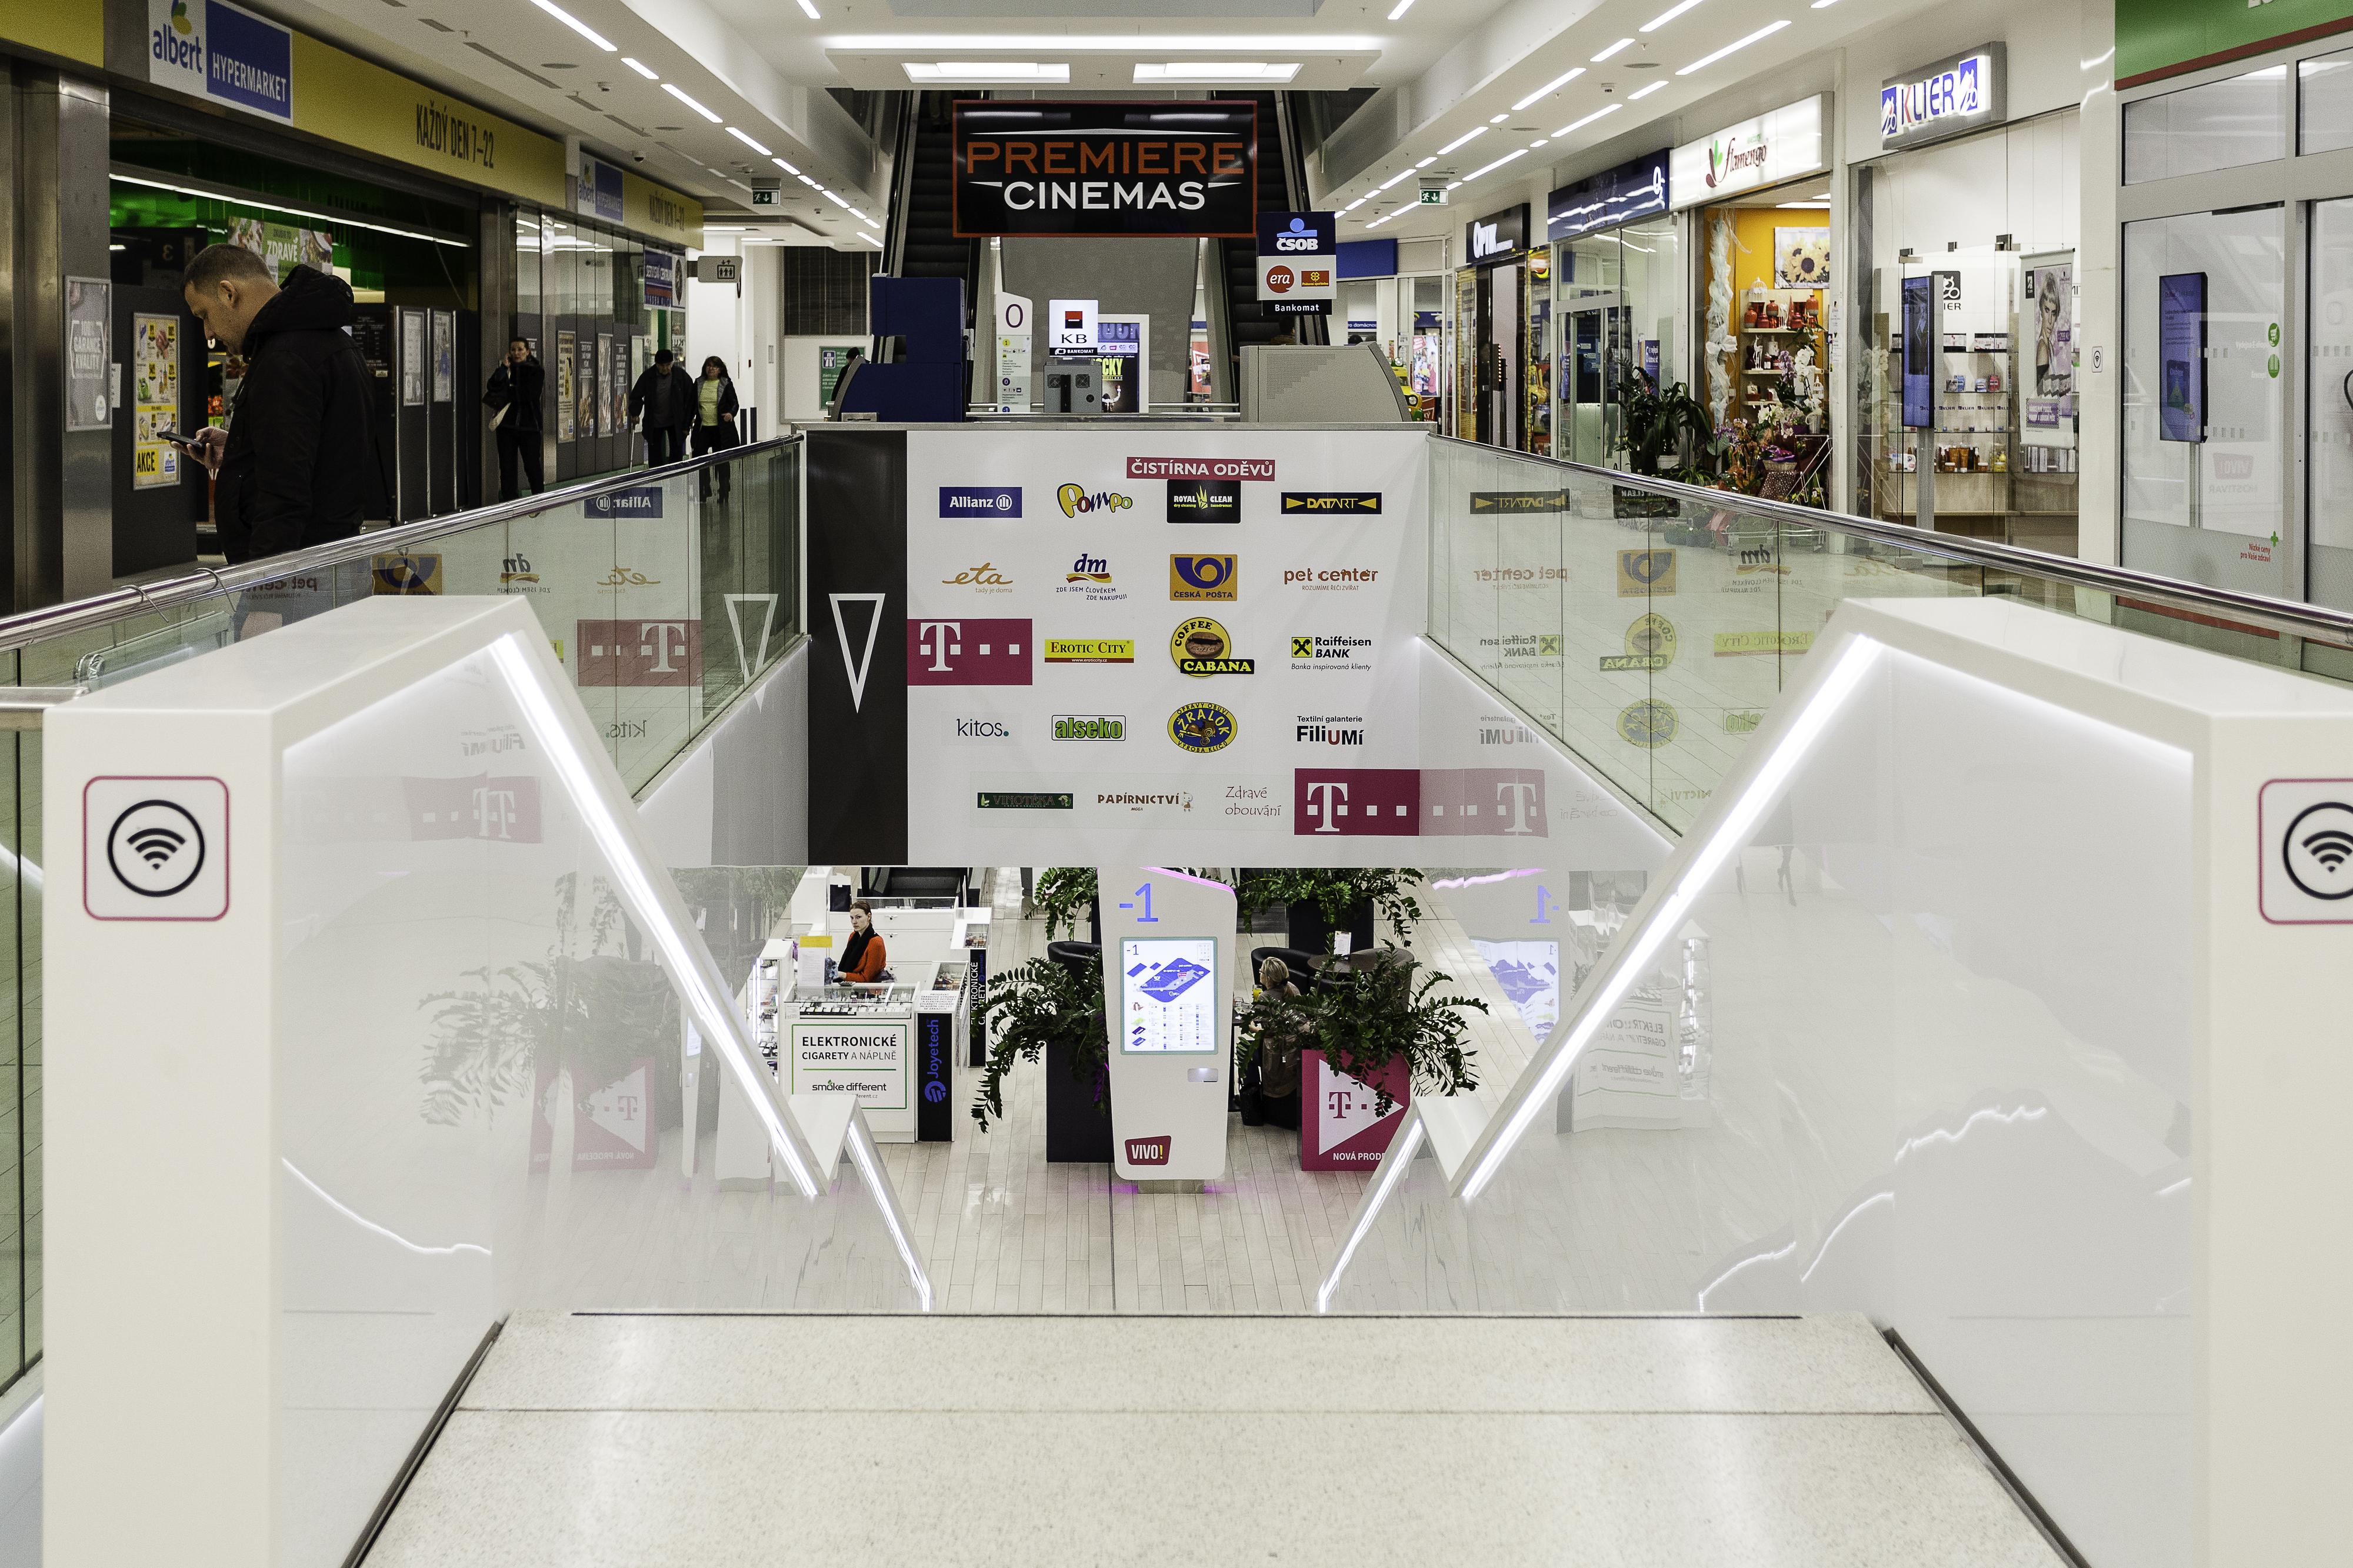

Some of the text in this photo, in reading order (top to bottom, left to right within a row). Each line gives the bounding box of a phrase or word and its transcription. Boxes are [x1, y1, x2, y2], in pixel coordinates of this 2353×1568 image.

[152, 24, 202, 74] albert
[213, 52, 286, 102] HYPERMARKET
[1902, 74, 1954, 125] KLIER
[416, 99, 448, 153] KAŽDÝ
[451, 116, 469, 161] DEN
[966, 142, 1244, 174] PREMIERE
[1004, 181, 1205, 209] CINEMAS
[267, 237, 298, 262] ZDRAVÉ
[1277, 238, 1318, 251] ČSOB
[1270, 274, 1290, 284] era
[1005, 303, 1023, 328] 0
[1061, 334, 1087, 343] KB
[137, 451, 155, 473] AKCE
[1131, 458, 1273, 477] ČISTÍRNA ODĚVŮ
[949, 496, 994, 508] Allianz
[1056, 483, 1134, 519] Pompo
[1307, 498, 1358, 509] DATART
[1074, 553, 1107, 572] dm
[942, 562, 1013, 585] eta
[1284, 568, 1378, 585] pet center
[1173, 589, 1233, 598] ČESKÁ POŠTA
[1174, 620, 1213, 647] COFFEE
[1315, 636, 1372, 646] Raiffeisen
[1315, 649, 1351, 658] BANK
[1184, 661, 1252, 672] CABANA
[1177, 703, 1204, 715] OPRAVY
[1176, 709, 1230, 735] ŽRALOK
[1325, 715, 1363, 724] galanterie
[1055, 718, 1123, 739] alseko
[993, 794, 1055, 805] VINOTÉKA
[1097, 792, 1179, 804] PAPÍRNICTVÍ
[1225, 786, 1268, 799] Zdravé
[1225, 803, 1281, 817] obouvání
[1119, 883, 1159, 923] -1
[802, 1033, 897, 1046] ELEKTRONICKÉ
[802, 1050, 896, 1060] CIGARETY A NÁPLNĚ
[927, 1019, 941, 1079] Joyetech
[812, 1081, 887, 1091] smoke different
[1131, 1145, 1164, 1160] VIVO!
[1333, 1151, 1356, 1160] NOVÁ
